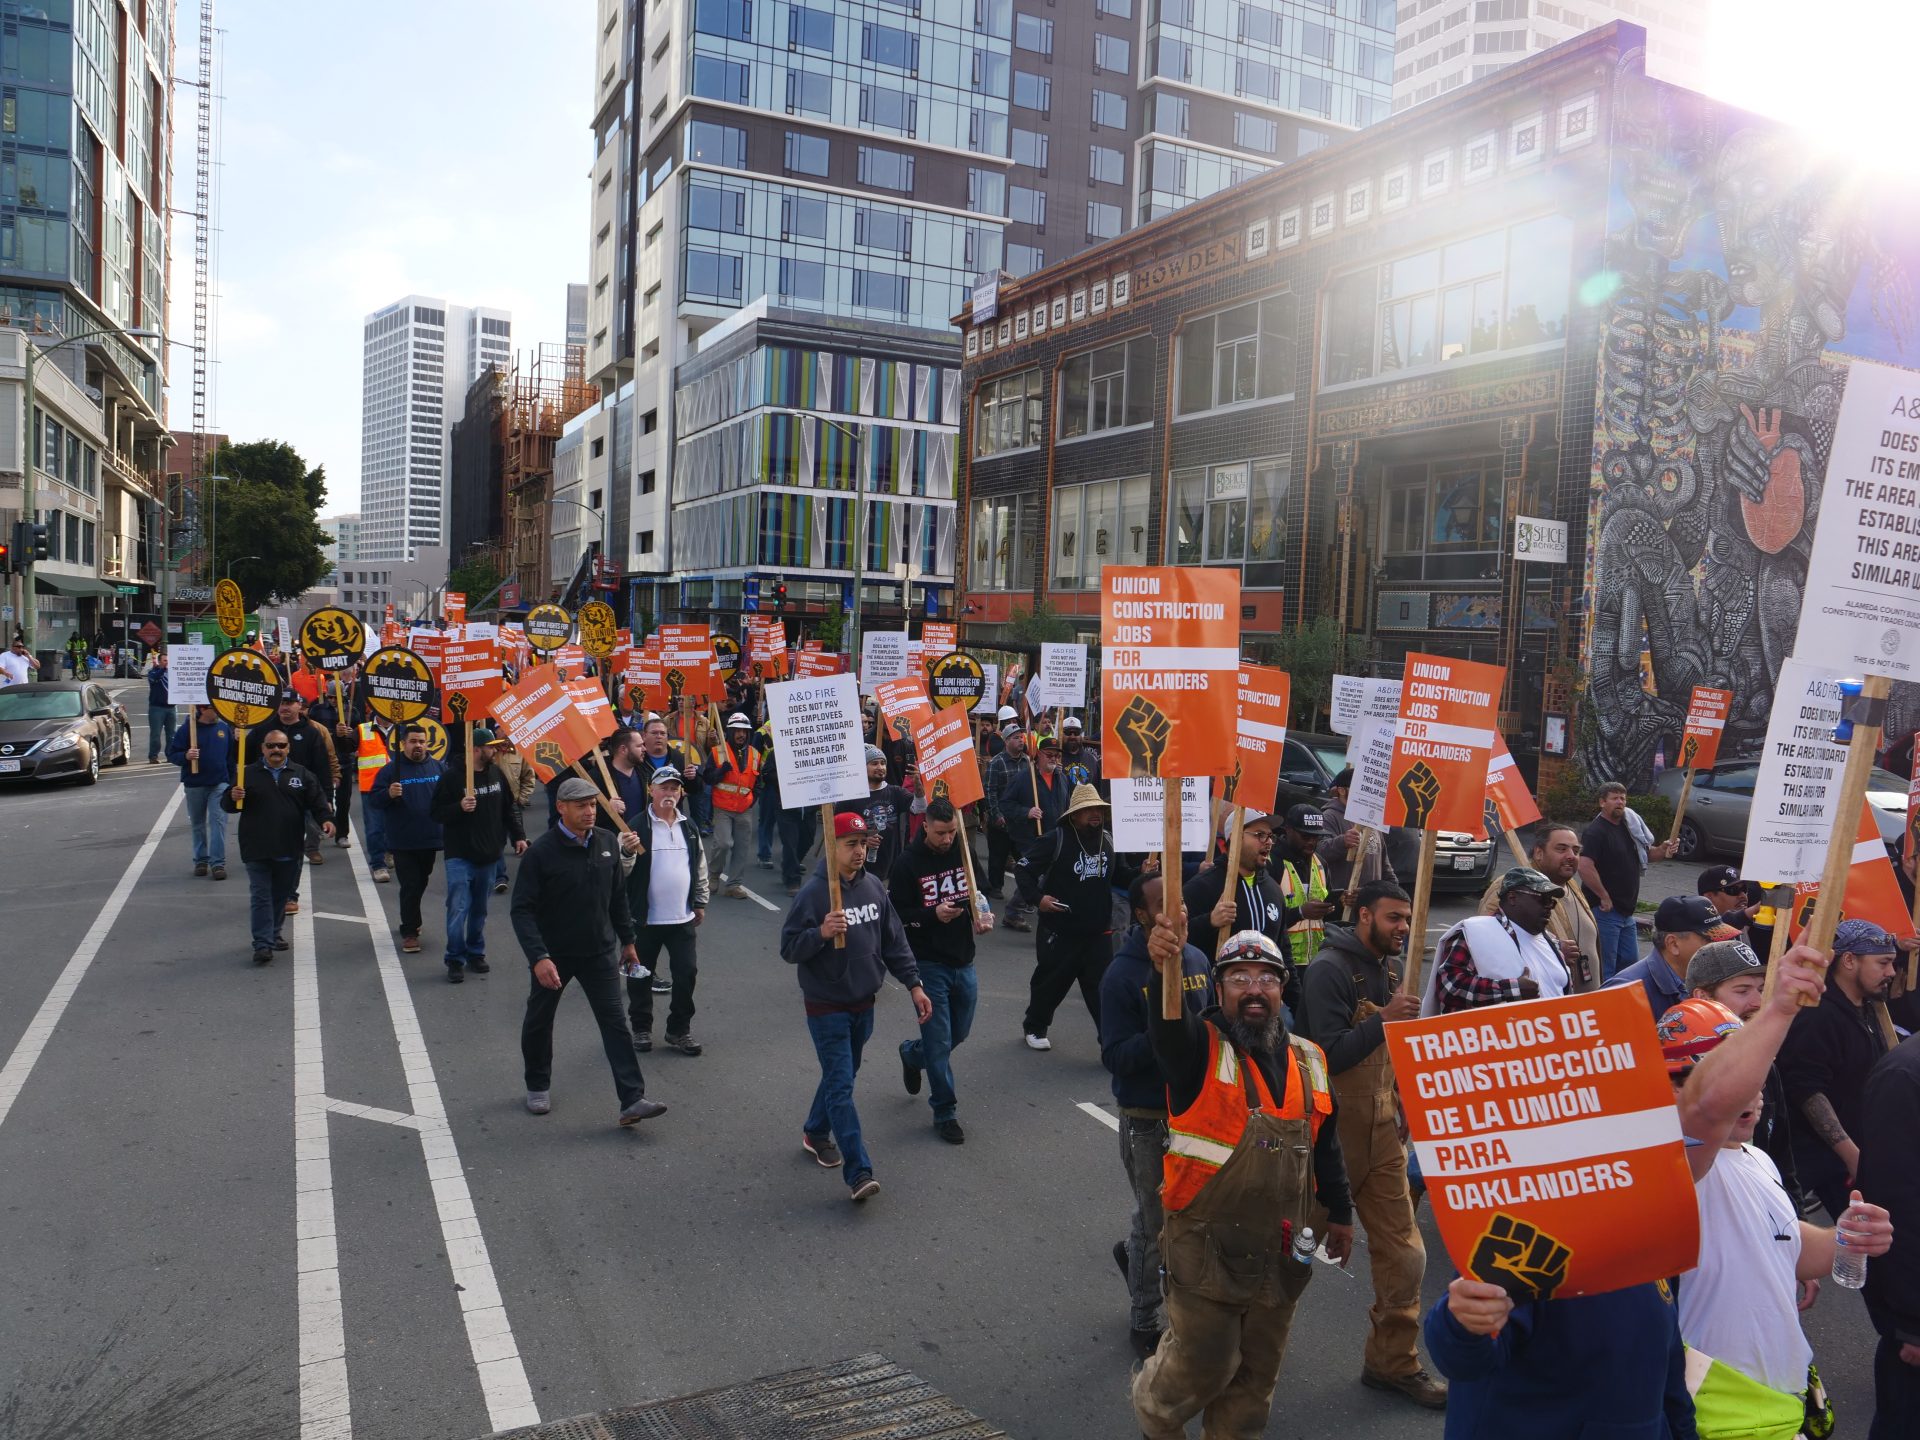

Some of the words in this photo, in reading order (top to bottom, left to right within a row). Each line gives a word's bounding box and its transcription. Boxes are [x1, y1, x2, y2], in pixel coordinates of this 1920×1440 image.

[1135, 237, 1239, 291] HOWDEN
[1326, 405, 1389, 433] ROBERT
[1397, 391, 1472, 421] HOWDEN
[1492, 377, 1548, 405] SONS
[1891, 395, 1920, 418] A&
[1880, 430, 1919, 453] DOES
[1870, 456, 1895, 476] ITS
[1846, 478, 1874, 500] THE
[1876, 484, 1916, 508] AREA
[1858, 536, 1890, 557] THIS
[1852, 562, 1910, 588] SIMILAR
[1112, 577, 1160, 595] UNION
[1113, 601, 1224, 620] CONSTRUCTION
[1822, 606, 1878, 622] CONSTRUCTION
[1904, 620, 1920, 629] COUNC
[1112, 626, 1152, 643] JOBS
[445, 646, 464, 654] UNION
[446, 652, 489, 664] CONSTRUCTION
[1113, 650, 1141, 667] FOR
[322, 656, 348, 668] IUPAT
[446, 664, 462, 672] JOBS
[1854, 655, 1868, 664] THIS
[1412, 662, 1450, 681] UNION
[214, 676, 224, 686] THE
[225, 678, 241, 690] IUPAT
[242, 680, 262, 694] FIGHTS
[263, 684, 276, 696] FOR
[368, 675, 378, 685] THE
[380, 676, 395, 688] IUPAT
[396, 678, 415, 690] FIGHTS
[416, 680, 428, 692] FOR
[446, 680, 484, 690] OAKLANDERS
[934, 678, 944, 686] THE
[944, 678, 957, 686] IUPAT
[958, 678, 972, 686] FIGHTS
[972, 678, 980, 686] FOR
[1113, 672, 1208, 690] OAKLANDERS
[218, 688, 245, 702] WORKING
[246, 692, 268, 706] PEOPLE
[374, 687, 400, 700] WORKING
[400, 690, 422, 702] PEOPLE
[788, 690, 812, 703] A&D
[816, 688, 836, 698] FIRE
[938, 686, 959, 695] WORKING
[960, 686, 976, 696] PEOPLE
[1238, 688, 1280, 708] STRUCTION
[1410, 682, 1490, 707] CONSTRUCTION
[494, 694, 516, 714] UNION
[500, 683, 552, 723] CONSTRUCTION
[788, 704, 808, 714] DOES
[808, 702, 823, 711] NOT
[824, 700, 839, 710] PAY
[1406, 702, 1438, 720] JOBS
[509, 714, 528, 732] JOBS
[788, 716, 800, 725] ITS
[801, 710, 843, 724] EMPLOYEES
[1800, 706, 1818, 720] DOES
[1828, 710, 1841, 724] PAY
[514, 726, 530, 740] FOR
[520, 714, 566, 748] OAKLANDERS
[780, 728, 794, 738] THE
[796, 725, 814, 736] AREA
[816, 720, 854, 732] STANDARD
[916, 722, 934, 738] UNION
[919, 719, 962, 750] CONSTRUCTION
[1404, 722, 1428, 738] FOR
[1793, 725, 1808, 739] ITS
[1808, 727, 1836, 742] EMPLOYEE
[790, 734, 836, 747] ESTABLISHED
[792, 748, 810, 758] THIS
[811, 746, 830, 756] AREA
[832, 744, 845, 752] FOR
[922, 746, 936, 760] JOBS
[1401, 740, 1472, 762] OAKLANDERS
[1776, 742, 1796, 758] THE
[1796, 746, 1816, 760] AREA
[794, 758, 825, 769] SIMILAR
[826, 754, 848, 764] WORK
[924, 759, 936, 770] FOR
[926, 754, 962, 781] OAKLANDERS
[1134, 777, 1152, 787] THIS
[1824, 767, 1834, 780] IN
[1784, 784, 1802, 798] THIS
[922, 872, 968, 900] 342
[843, 903, 880, 926] SMC
[1405, 1016, 1556, 1062] TRABAJOS
[1560, 1009, 1600, 1040] DE
[1416, 1040, 1636, 1099] CONSTRUCCIÓN
[1425, 1106, 1463, 1136] DE
[1466, 1100, 1505, 1131] LA
[1508, 1082, 1602, 1126] UNIÓN
[1434, 1138, 1512, 1172] PARA
[1445, 1160, 1634, 1210] OAKLANDERS
